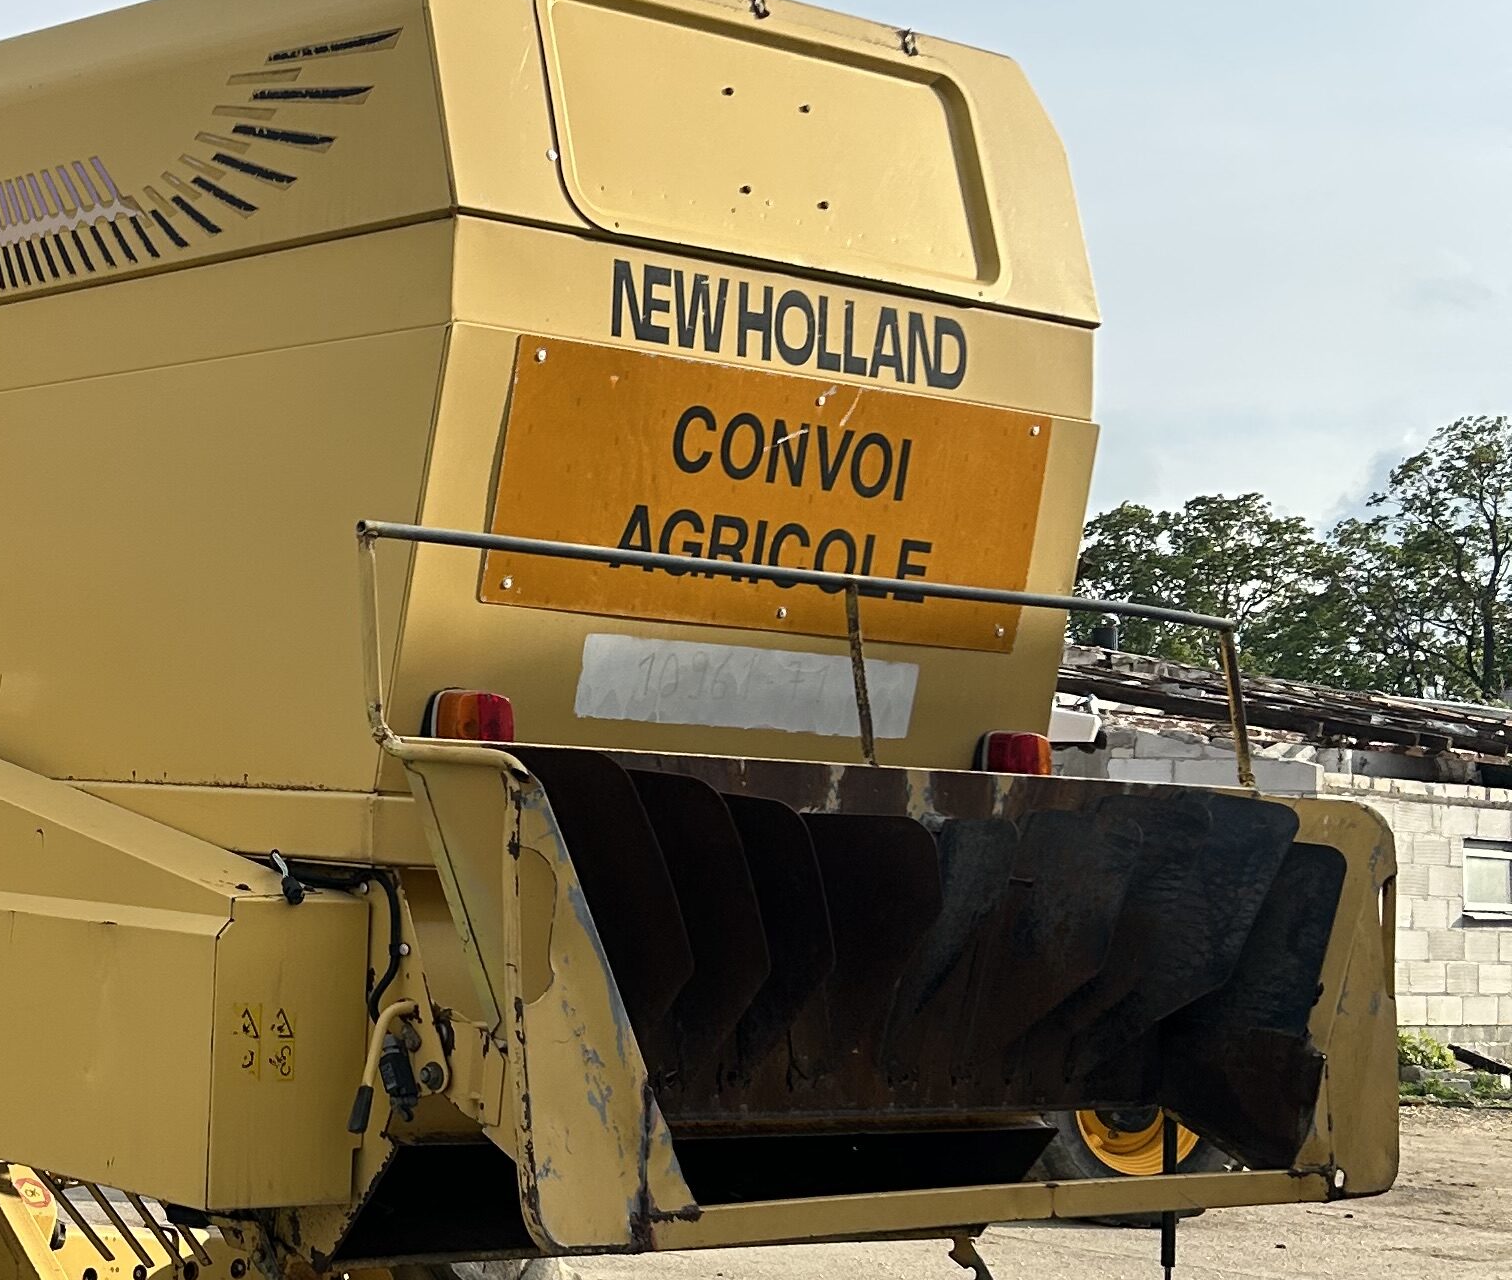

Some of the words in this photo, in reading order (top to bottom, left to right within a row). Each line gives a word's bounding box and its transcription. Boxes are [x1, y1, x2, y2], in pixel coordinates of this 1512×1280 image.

[610, 258, 730, 354] NEW
[736, 281, 968, 390] HOLLAND
[672, 405, 913, 502] CONVOI
[608, 503, 933, 604] AGRICOLE
